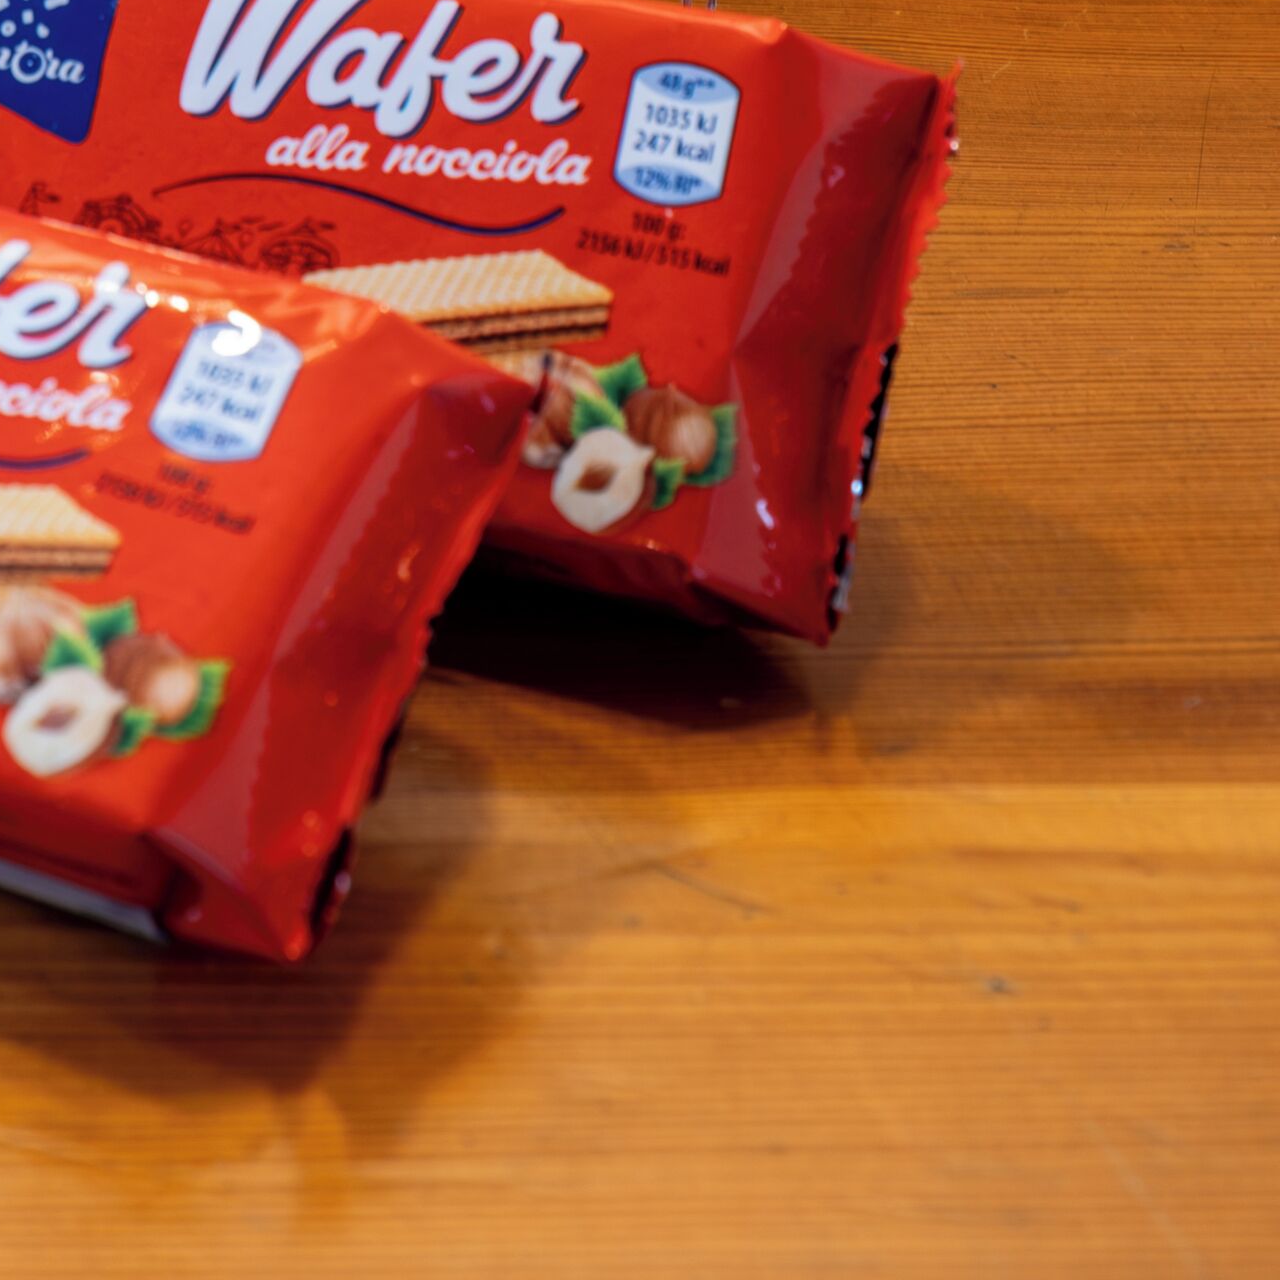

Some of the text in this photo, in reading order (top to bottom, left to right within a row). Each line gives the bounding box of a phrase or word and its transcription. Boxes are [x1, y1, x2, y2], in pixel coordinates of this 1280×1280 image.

[646, 103, 718, 135] 1035 kJ
[266, 124, 591, 185] alla nocciola
[634, 130, 716, 164] 247 kcal
